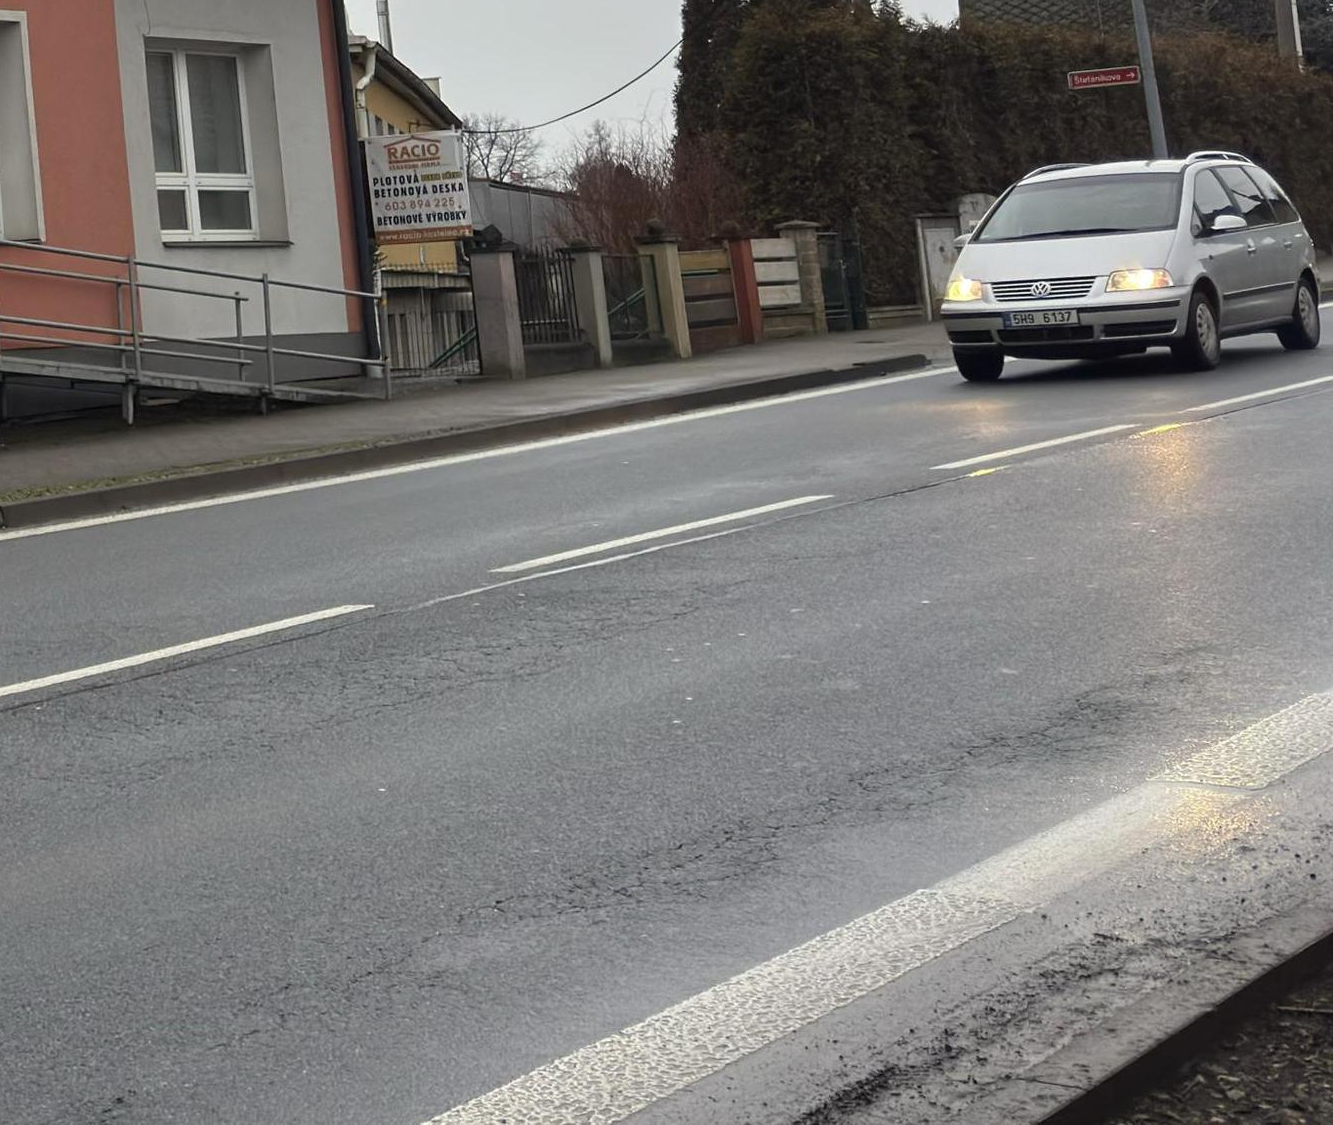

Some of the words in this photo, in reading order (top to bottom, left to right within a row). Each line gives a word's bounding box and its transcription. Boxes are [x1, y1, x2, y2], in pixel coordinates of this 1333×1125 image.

[387, 143, 440, 159] RACIO
[432, 182, 464, 194] DESKA
[385, 201, 407, 211] 603
[410, 199, 431, 209] 894
[434, 197, 455, 208] 225
[1043, 311, 1072, 324] 6137
